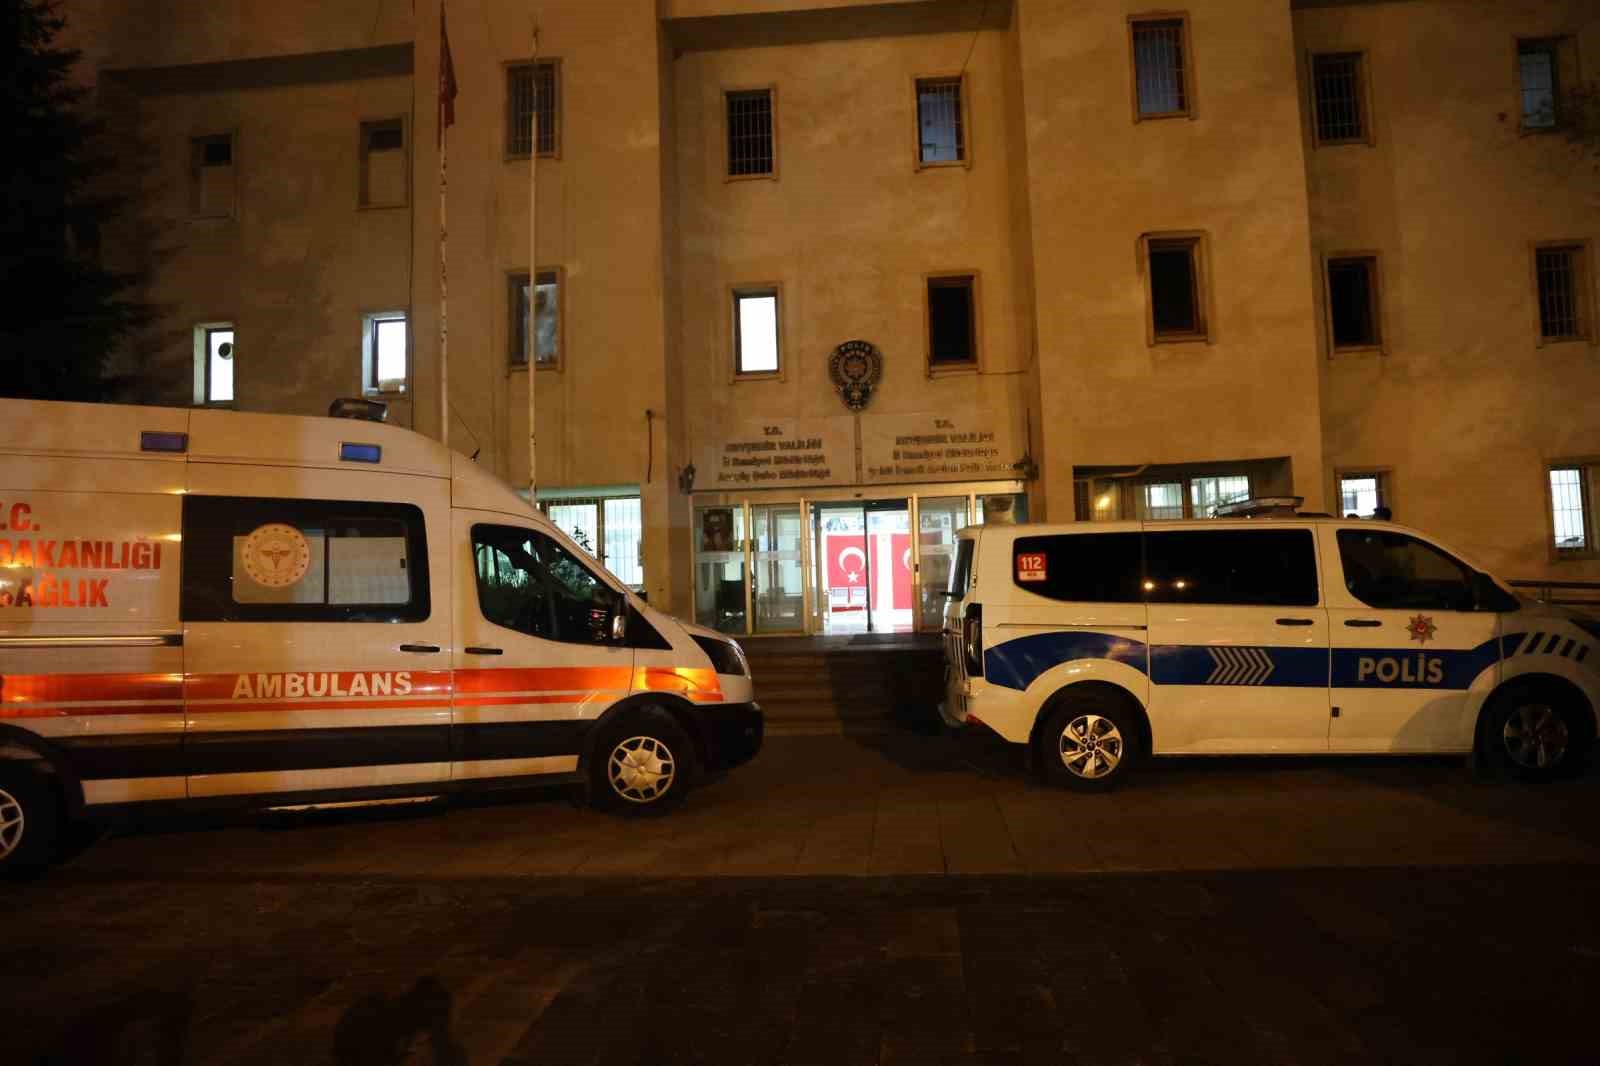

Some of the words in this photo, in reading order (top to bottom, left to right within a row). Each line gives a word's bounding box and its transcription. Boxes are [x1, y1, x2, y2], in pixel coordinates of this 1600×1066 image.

[0, 502, 41, 532] .C.
[1022, 556, 1042, 570] 112
[1358, 652, 1443, 684] POLİS
[231, 671, 412, 699] AMBULANS
